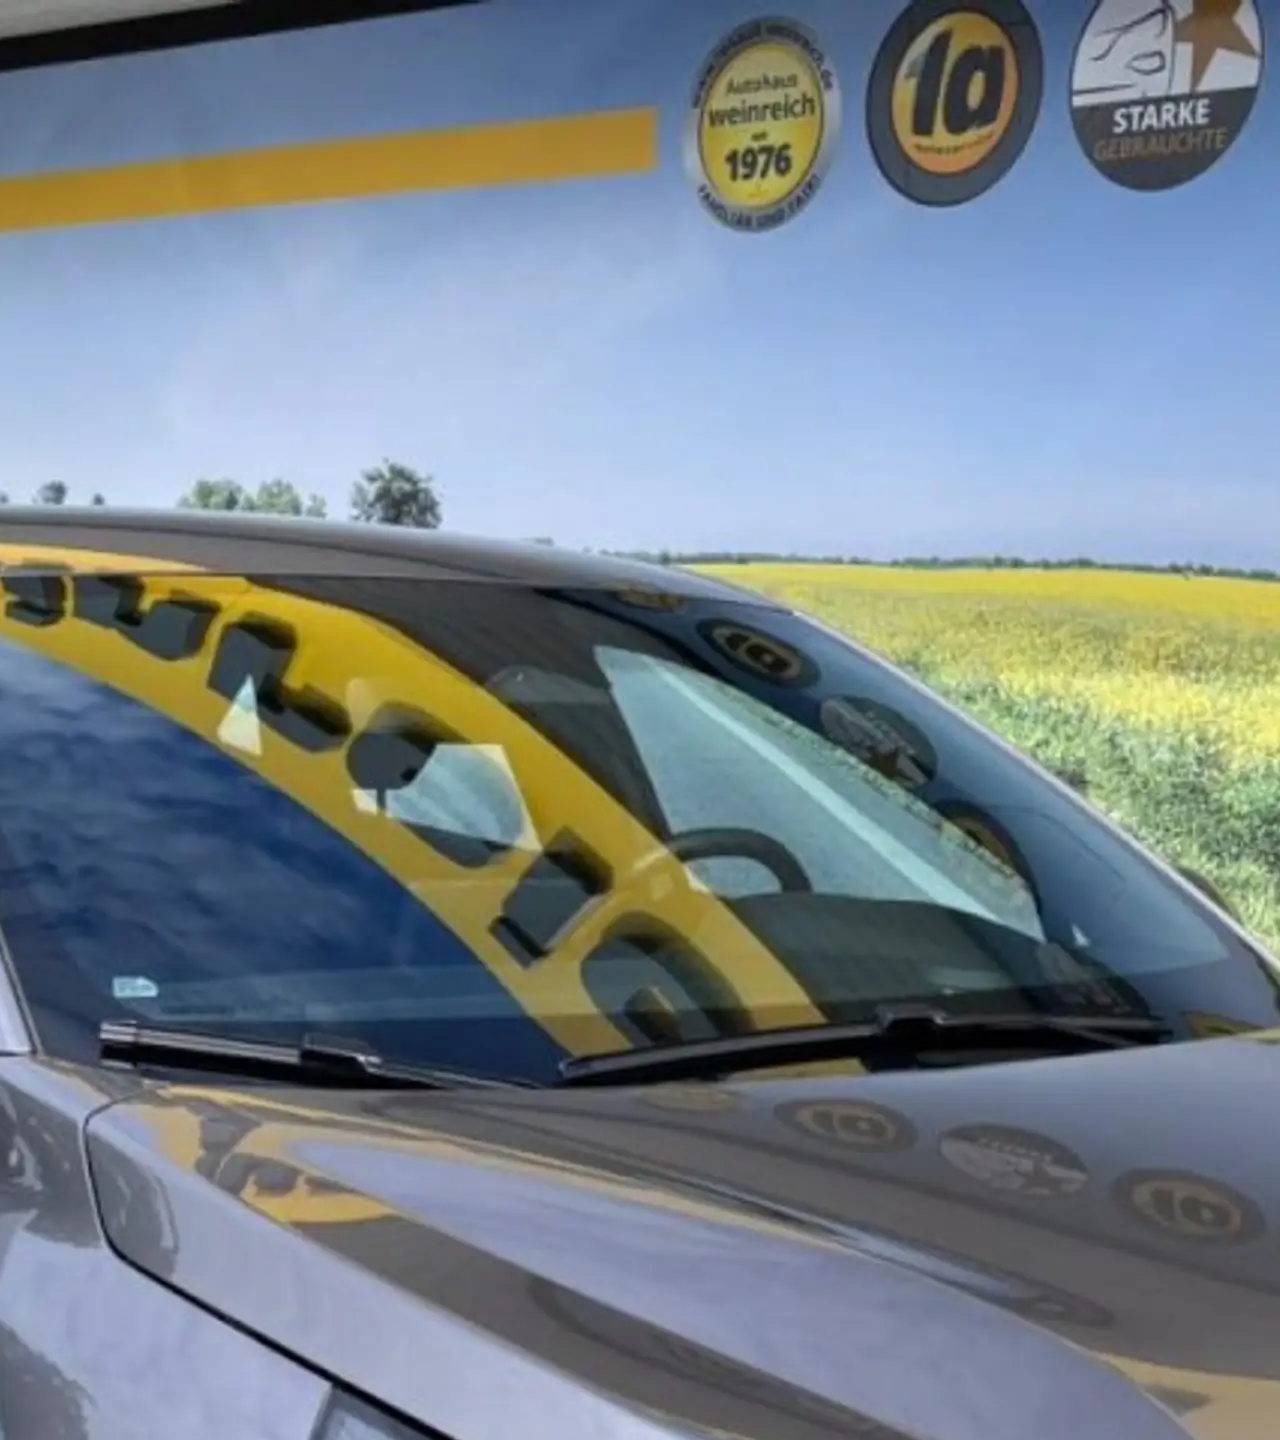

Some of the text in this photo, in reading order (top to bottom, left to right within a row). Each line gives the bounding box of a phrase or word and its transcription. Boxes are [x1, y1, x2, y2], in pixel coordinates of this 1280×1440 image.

[726, 73, 798, 96] Autohaus
[904, 28, 1005, 136] 1a
[707, 91, 816, 128] weinreich
[1112, 98, 1211, 134] STARKE
[724, 142, 794, 183] 1976
[1092, 127, 1228, 162] GEBRAUCHTE
